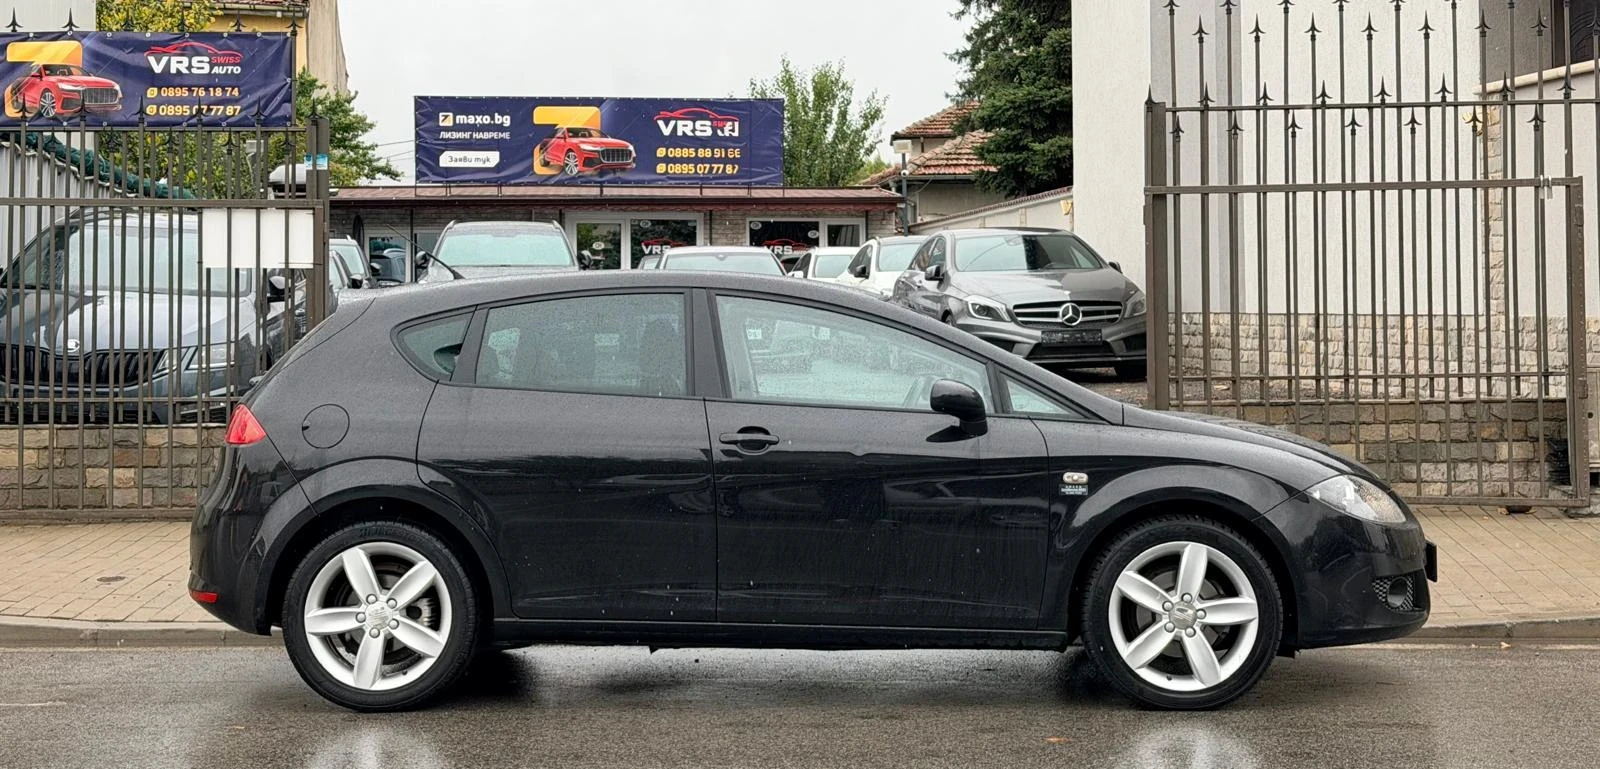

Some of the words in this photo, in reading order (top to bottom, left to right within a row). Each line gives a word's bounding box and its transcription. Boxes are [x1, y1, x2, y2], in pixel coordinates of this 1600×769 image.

[147, 56, 210, 74] VRS
[211, 56, 241, 64] SWISS
[211, 66, 241, 74] AUTO
[160, 87, 189, 97] 0895
[191, 87, 205, 97] 76
[209, 87, 222, 97] 18
[225, 87, 239, 97] 74
[159, 105, 190, 115] 0895
[209, 105, 224, 115] 77
[225, 105, 241, 115] 87
[456, 112, 511, 127] maxo.bg
[656, 120, 713, 136] VRS
[439, 131, 472, 139] ЛИЗИНГ
[473, 131, 511, 139] НАВРЕМЕ
[667, 148, 696, 158] 0885
[697, 148, 712, 158] 88
[448, 155, 473, 163] Заяви
[474, 156, 490, 164] тук
[667, 164, 696, 174] 0895
[696, 164, 710, 174] 07
[711, 164, 724, 174] 77
